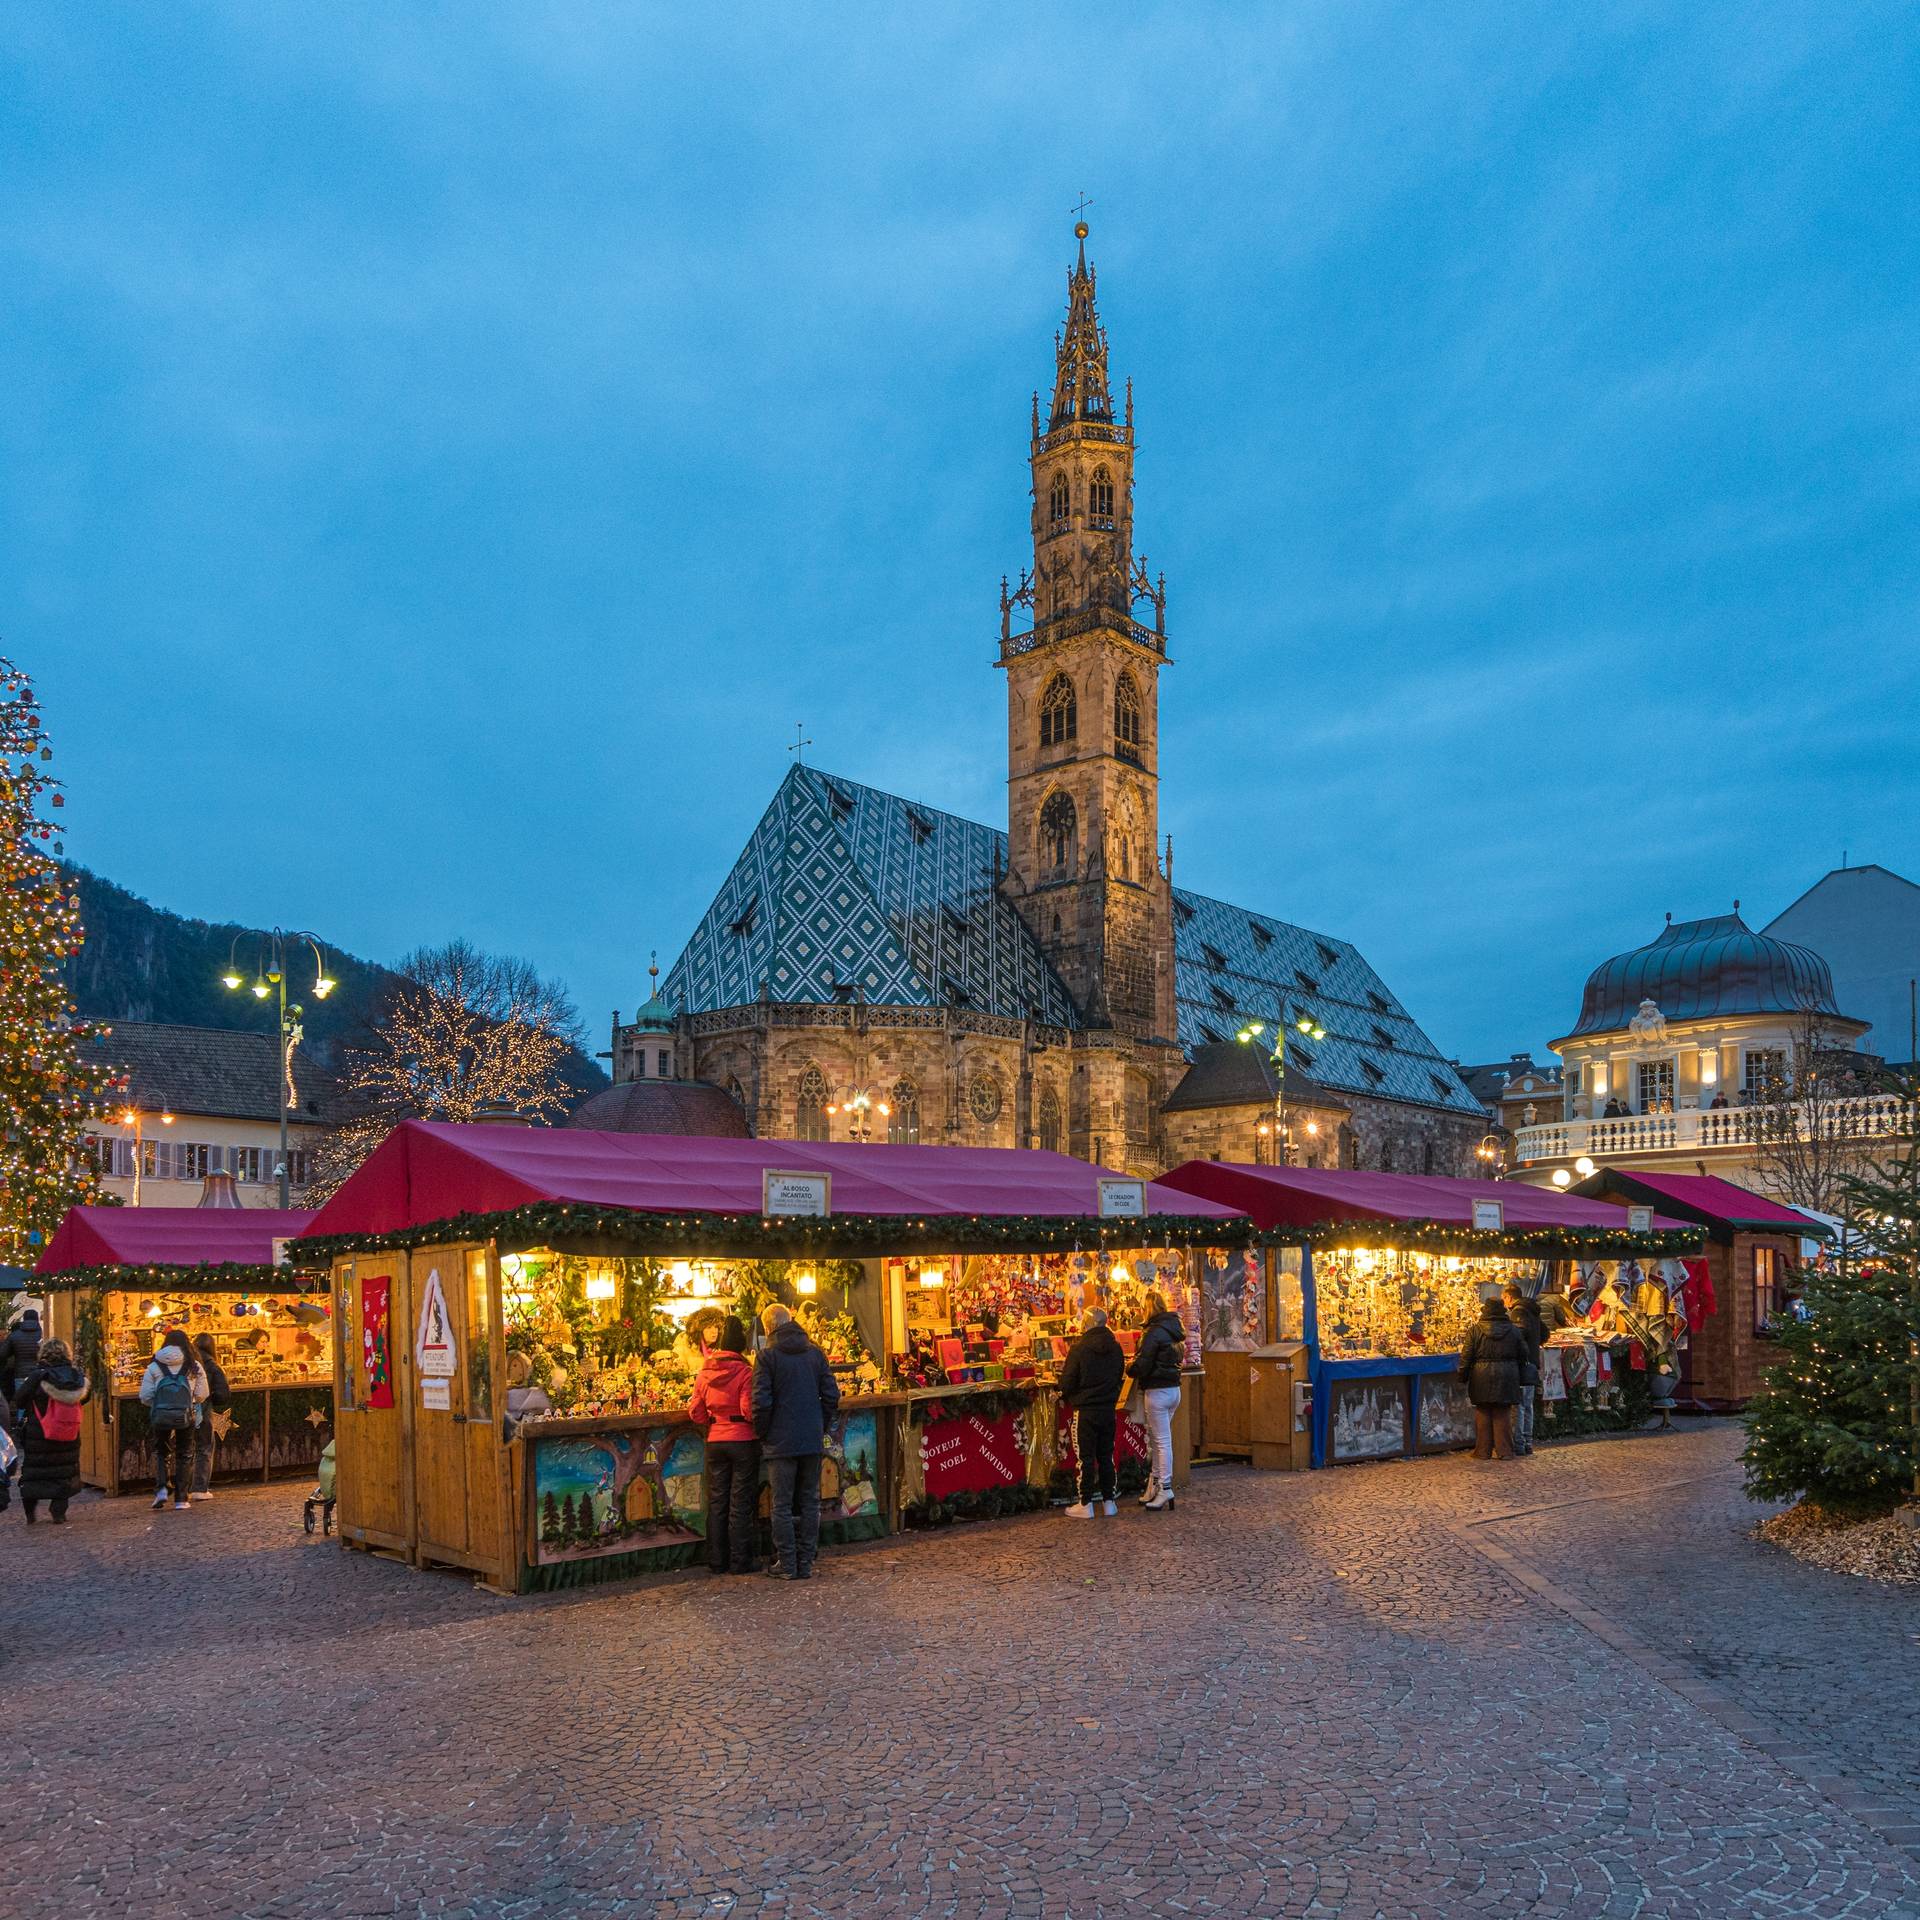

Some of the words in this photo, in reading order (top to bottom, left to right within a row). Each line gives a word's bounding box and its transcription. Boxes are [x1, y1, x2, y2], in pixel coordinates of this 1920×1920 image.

[969, 1416, 995, 1443] FELIZ
[1124, 1416, 1144, 1438] BUON
[924, 1436, 961, 1460] JOYEUX
[940, 1453, 967, 1472] NOEL
[979, 1444, 1014, 1481] NAVIDAD
